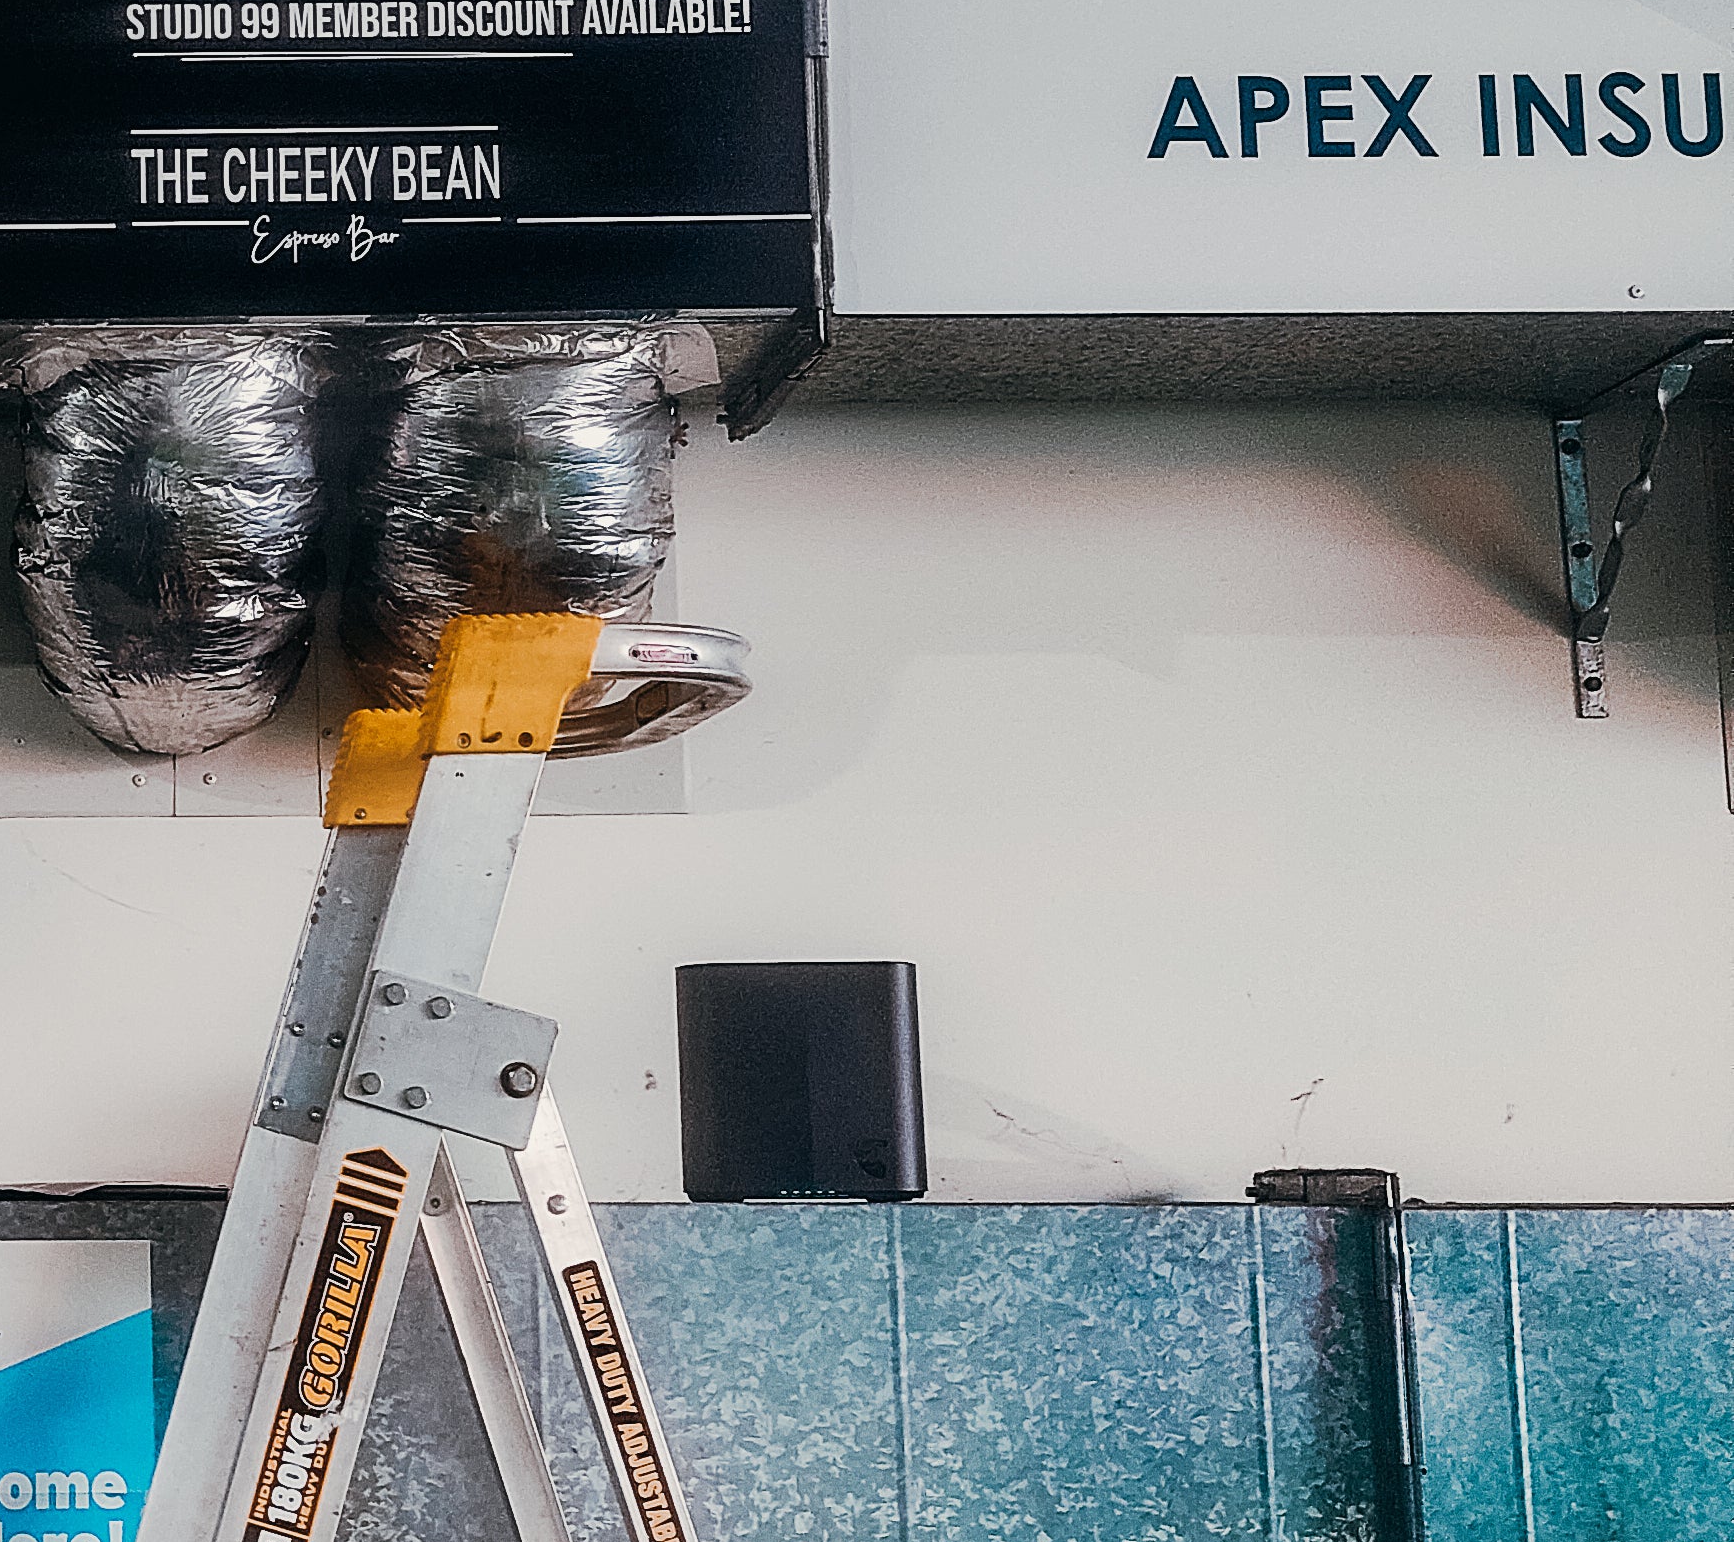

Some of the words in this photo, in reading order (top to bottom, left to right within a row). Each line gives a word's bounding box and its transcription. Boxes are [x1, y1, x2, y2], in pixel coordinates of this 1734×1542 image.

[126, 3, 233, 40] STUDIO
[240, 2, 280, 40] 99
[288, 1, 419, 39] MEMBER
[426, 0, 575, 37] DISCOUNT
[1147, 74, 1438, 159] APEX
[130, 148, 209, 204] THE
[223, 146, 380, 204] CHEEKY
[392, 144, 501, 201] BEAN
[251, 214, 341, 264] Espresso
[346, 213, 400, 262] Bar
[299, 1223, 380, 1410] GORILLA
[569, 1269, 616, 1346] HEAVY
[595, 1353, 638, 1414] DUTY
[253, 1408, 292, 1519] INDUSTRIAL
[267, 1413, 328, 1524] 180KG
[297, 1471, 320, 1530] HEAVY
